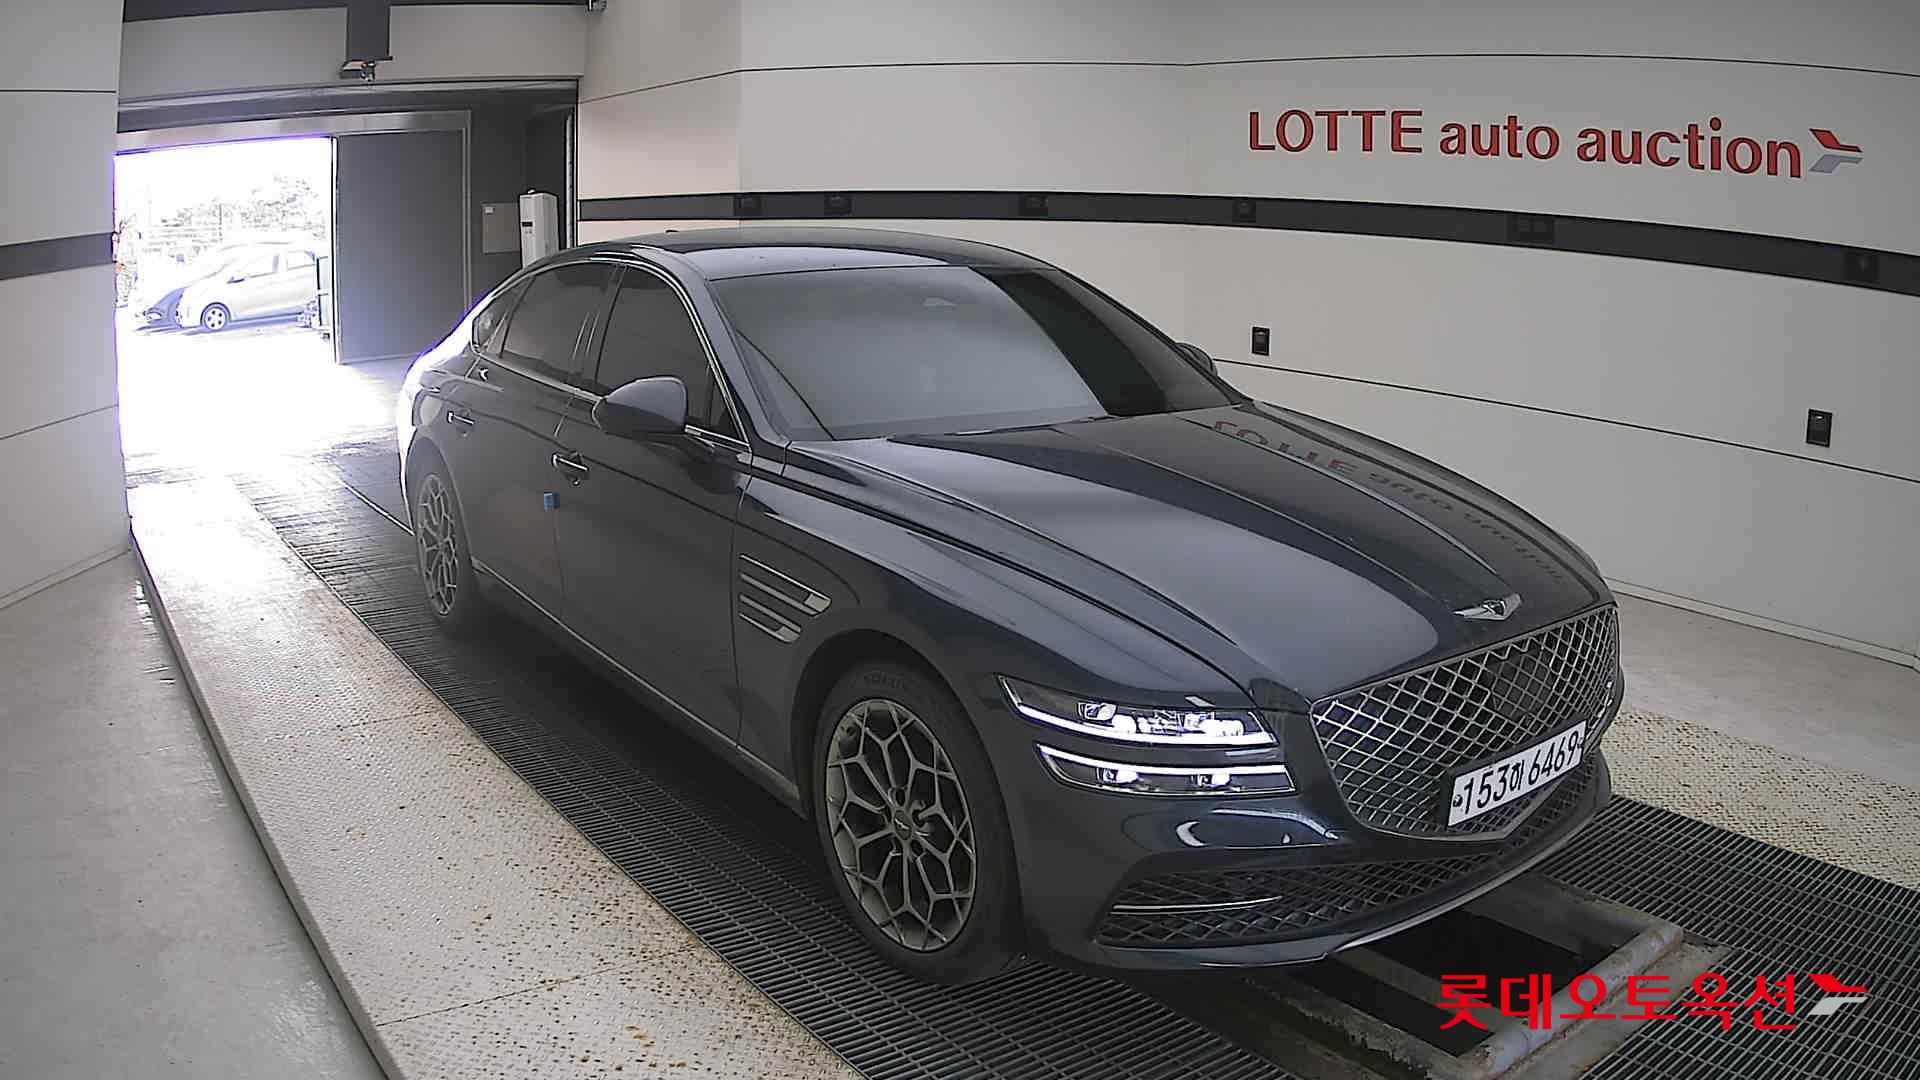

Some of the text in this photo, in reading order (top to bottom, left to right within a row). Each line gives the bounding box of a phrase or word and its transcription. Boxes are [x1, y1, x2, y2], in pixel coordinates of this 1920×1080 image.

[1249, 110, 1802, 178] LOTTE auto auction
